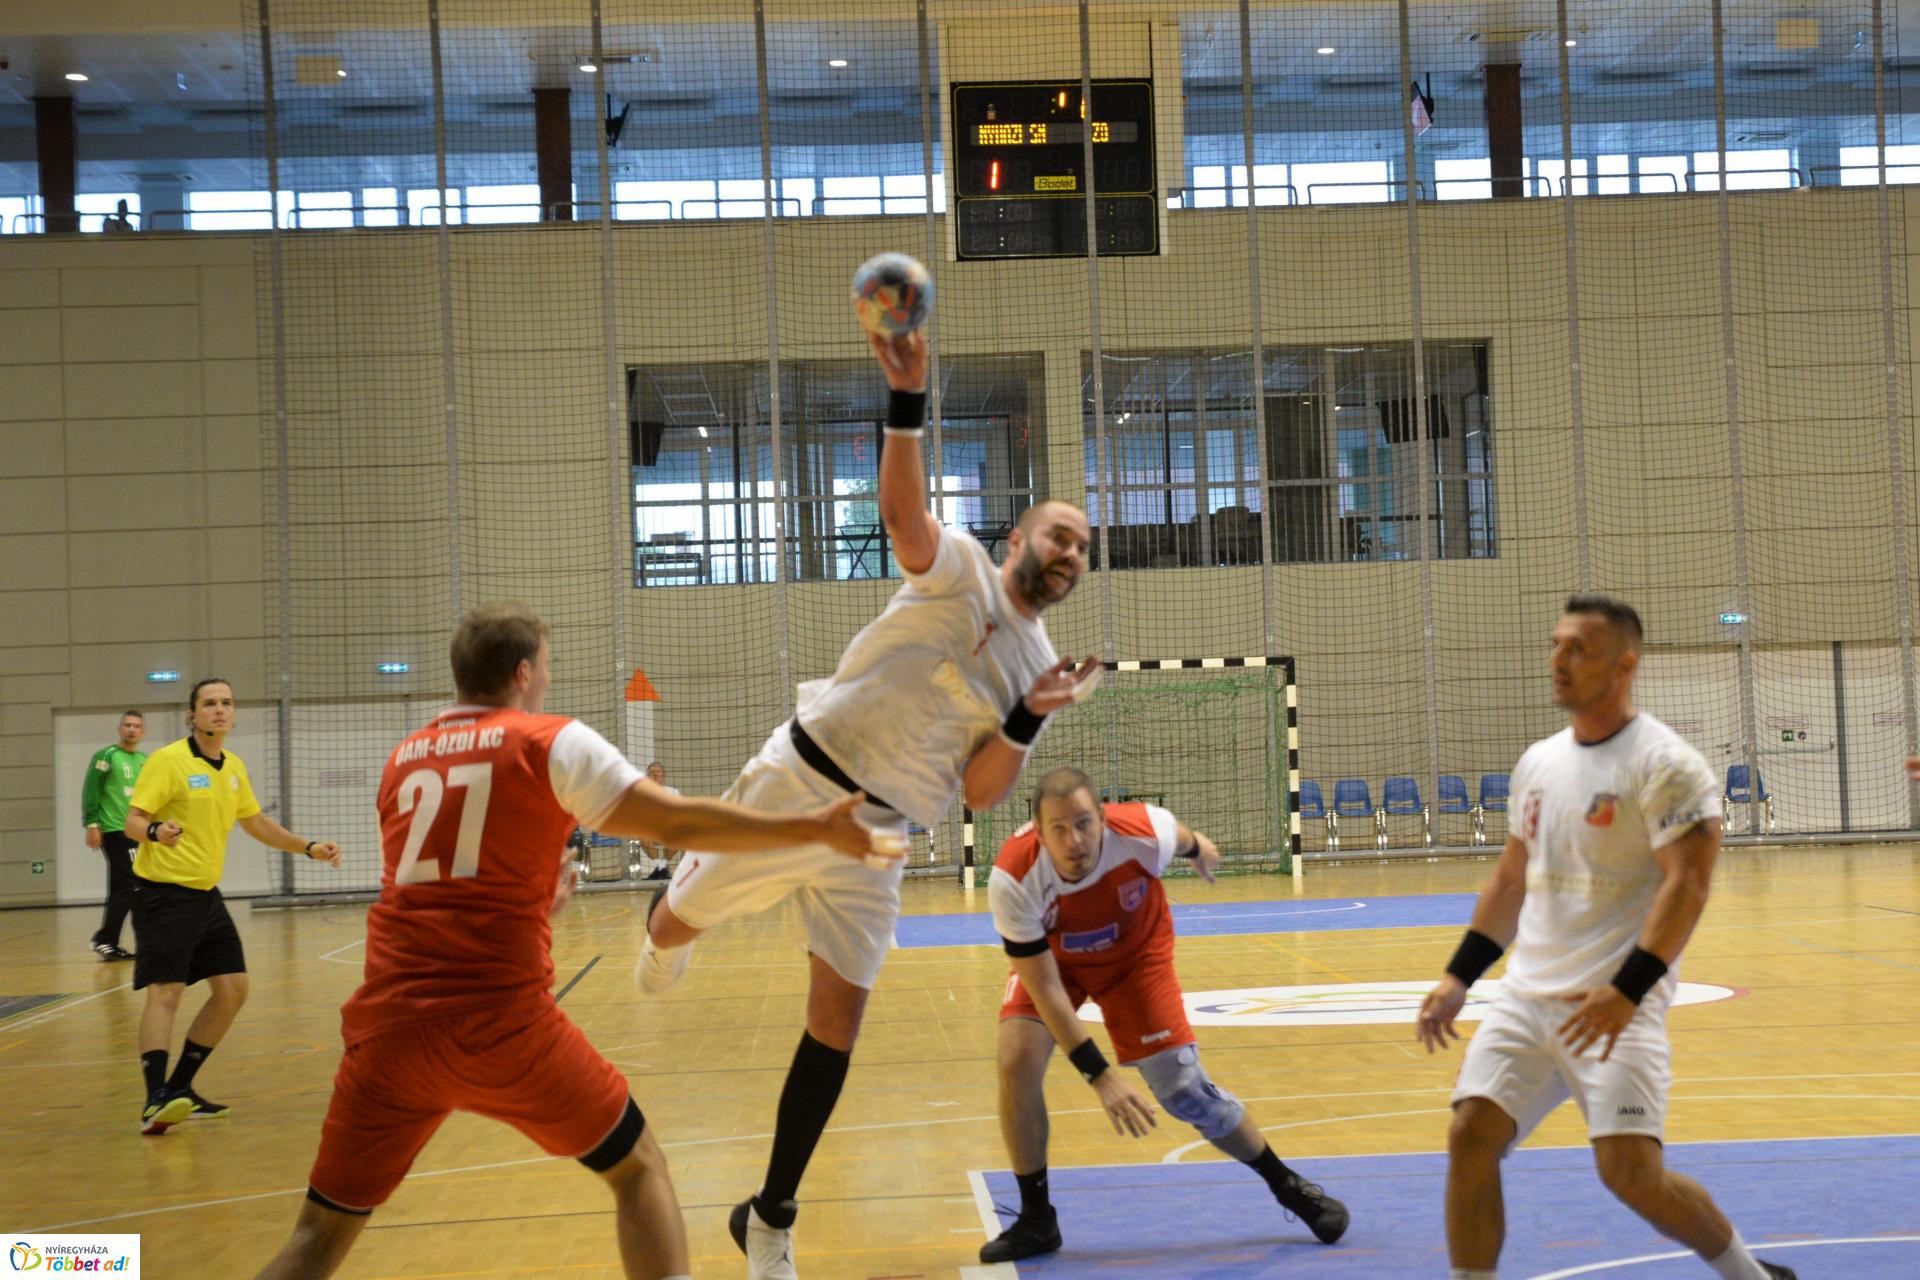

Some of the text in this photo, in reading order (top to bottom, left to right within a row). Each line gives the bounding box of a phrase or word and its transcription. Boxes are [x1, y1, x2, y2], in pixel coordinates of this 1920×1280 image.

[1038, 178, 1074, 189] Bodet
[478, 726, 505, 749] KC
[395, 761, 493, 886] 27
